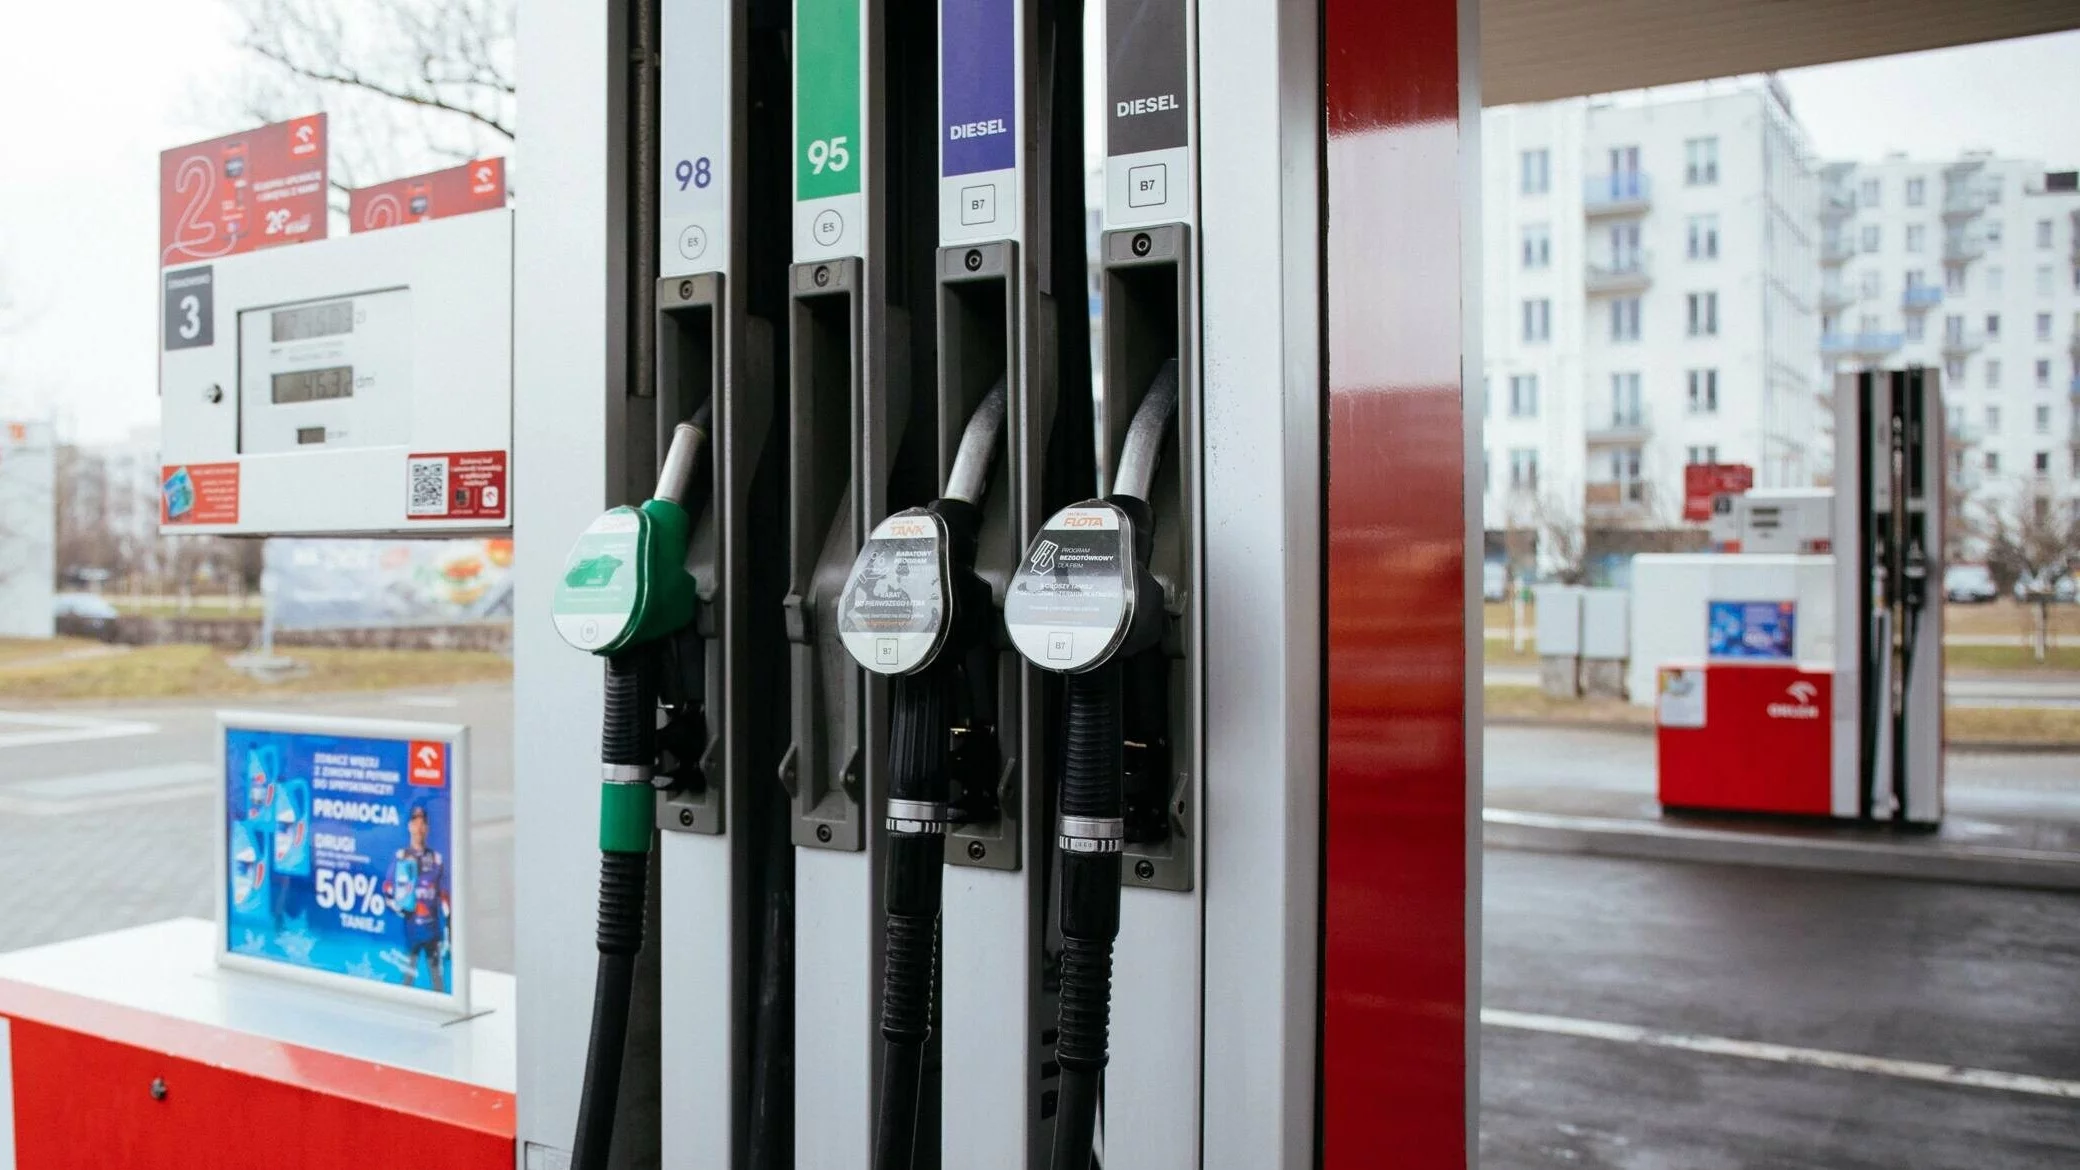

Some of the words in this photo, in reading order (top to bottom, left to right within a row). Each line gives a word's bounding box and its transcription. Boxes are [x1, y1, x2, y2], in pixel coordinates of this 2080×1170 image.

[1116, 94, 1179, 117] DIESEL
[950, 119, 1007, 140] DIESEL
[808, 136, 849, 175] 95
[675, 157, 711, 191] 98
[1140, 180, 1155, 191] B7
[972, 200, 985, 210] B7
[823, 223, 835, 233] E5
[688, 238, 699, 248] E5
[179, 294, 201, 340] 3
[1063, 517, 1104, 527] FLOTA
[1055, 641, 1065, 649] B7
[313, 797, 399, 826] PROMOCJA
[316, 868, 385, 916] 50%
